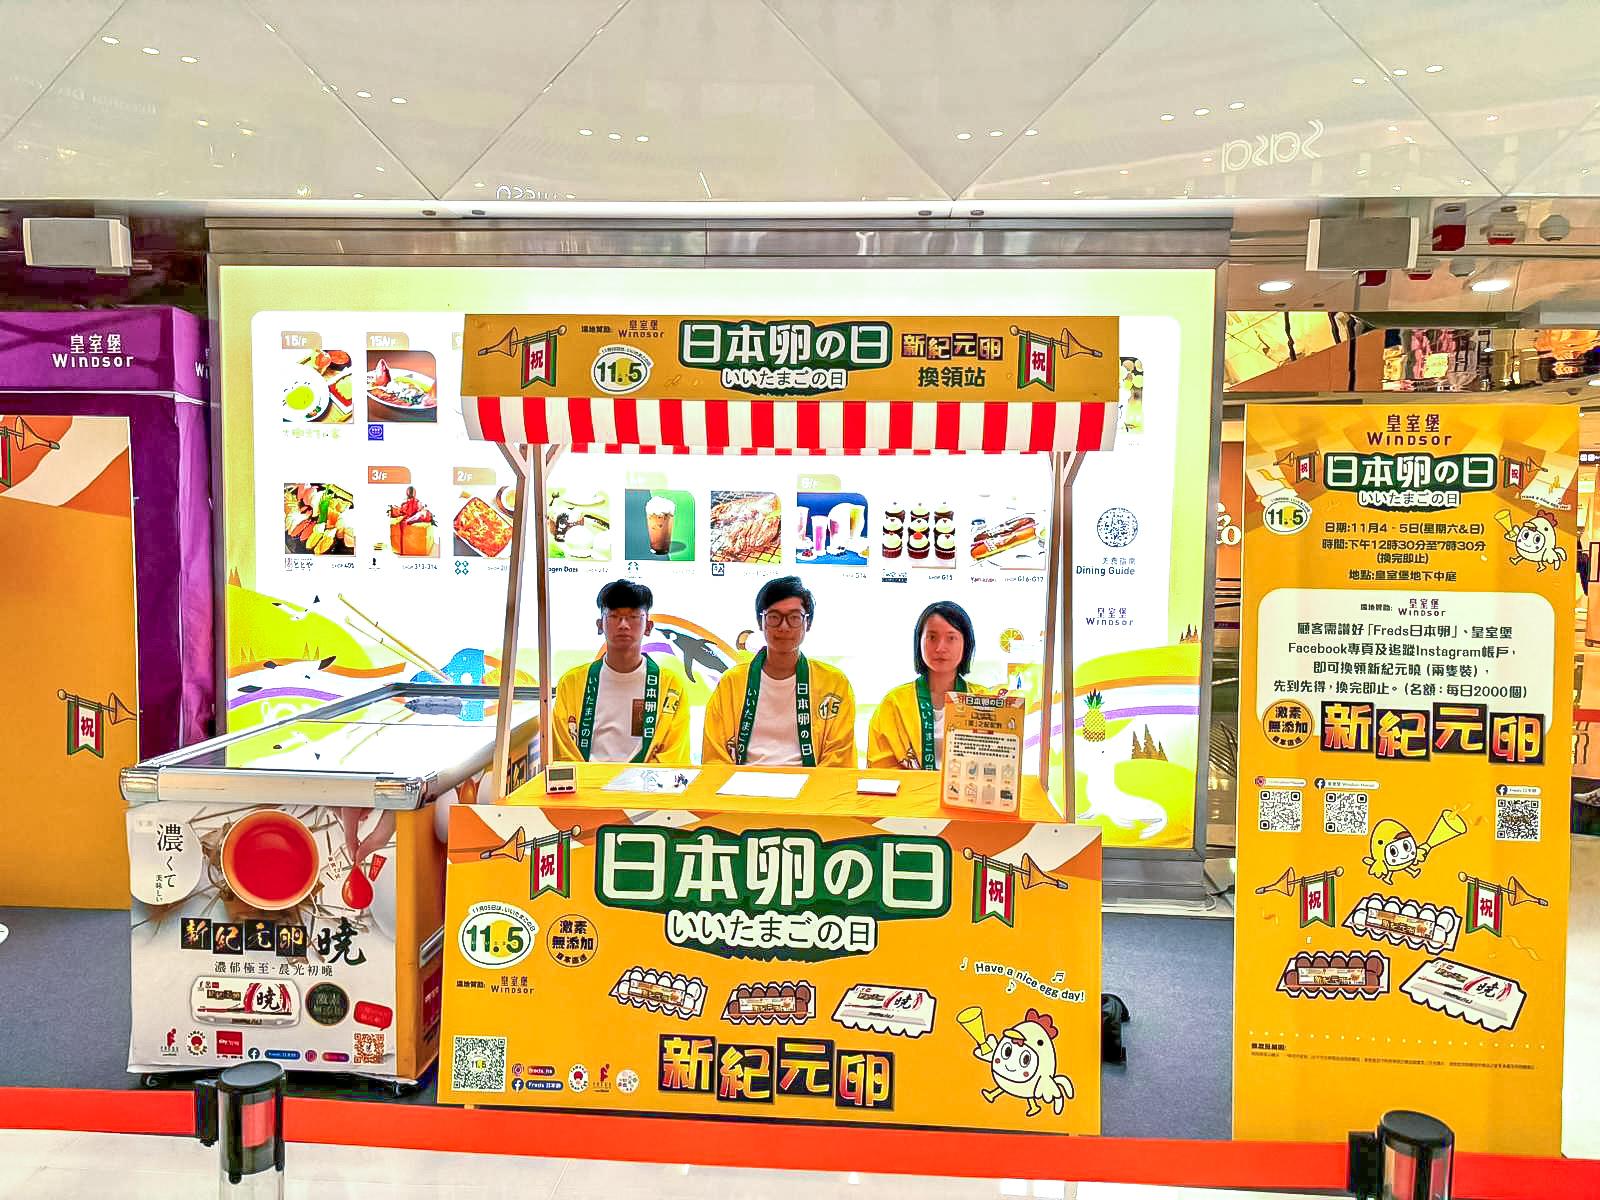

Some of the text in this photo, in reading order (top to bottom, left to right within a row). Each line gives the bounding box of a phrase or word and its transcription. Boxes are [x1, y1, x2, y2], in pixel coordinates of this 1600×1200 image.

[70, 334, 122, 353] 皇室堡
[683, 324, 890, 365] 日本卵の日
[902, 333, 1003, 360] 新紀元卵
[52, 353, 134, 368] Windsor
[531, 350, 543, 369] 祝
[1032, 351, 1046, 371] 祝
[597, 362, 642, 382] 11.5
[725, 370, 844, 387] いいたまごの日
[918, 366, 986, 388] 換領站
[1387, 414, 1439, 433] 皇室堡
[1367, 432, 1452, 446] Windsor
[372, 470, 388, 480] 3/F
[457, 471, 473, 482] 2/F
[1327, 455, 1494, 488] 日本卵の日
[1361, 490, 1458, 506] いいたまごの日
[1268, 509, 1303, 525] 11.5
[1076, 565, 1135, 576] Dining Guide
[1398, 608, 1446, 617] Windsor
[1409, 598, 1439, 609] 皇室堡
[1086, 617, 1134, 626] Windsor
[644, 674, 658, 738] 日本卵の日
[1275, 706, 1301, 719] 激素
[80, 716, 94, 738] 祝
[797, 683, 813, 757] 日本卵の日
[1269, 721, 1308, 734] 無添加
[1321, 701, 1545, 765] 新紀元卵
[157, 823, 184, 888] 濃くて
[540, 854, 555, 877] 祝
[602, 832, 944, 911] 日本卵の日
[988, 879, 1004, 903] 祝
[1308, 890, 1321, 909] 祝
[1480, 897, 1493, 917] 祝
[560, 919, 588, 934] 激素
[673, 914, 870, 946] いいたまごの日
[466, 925, 524, 954] 11.5
[552, 936, 594, 951] 無添加
[976, 962, 1004, 973] Have
[1016, 970, 1038, 988] nice
[1039, 984, 1059, 999] egg
[1061, 989, 1084, 1002] day!
[660, 1034, 895, 1109] 新紀元卵
